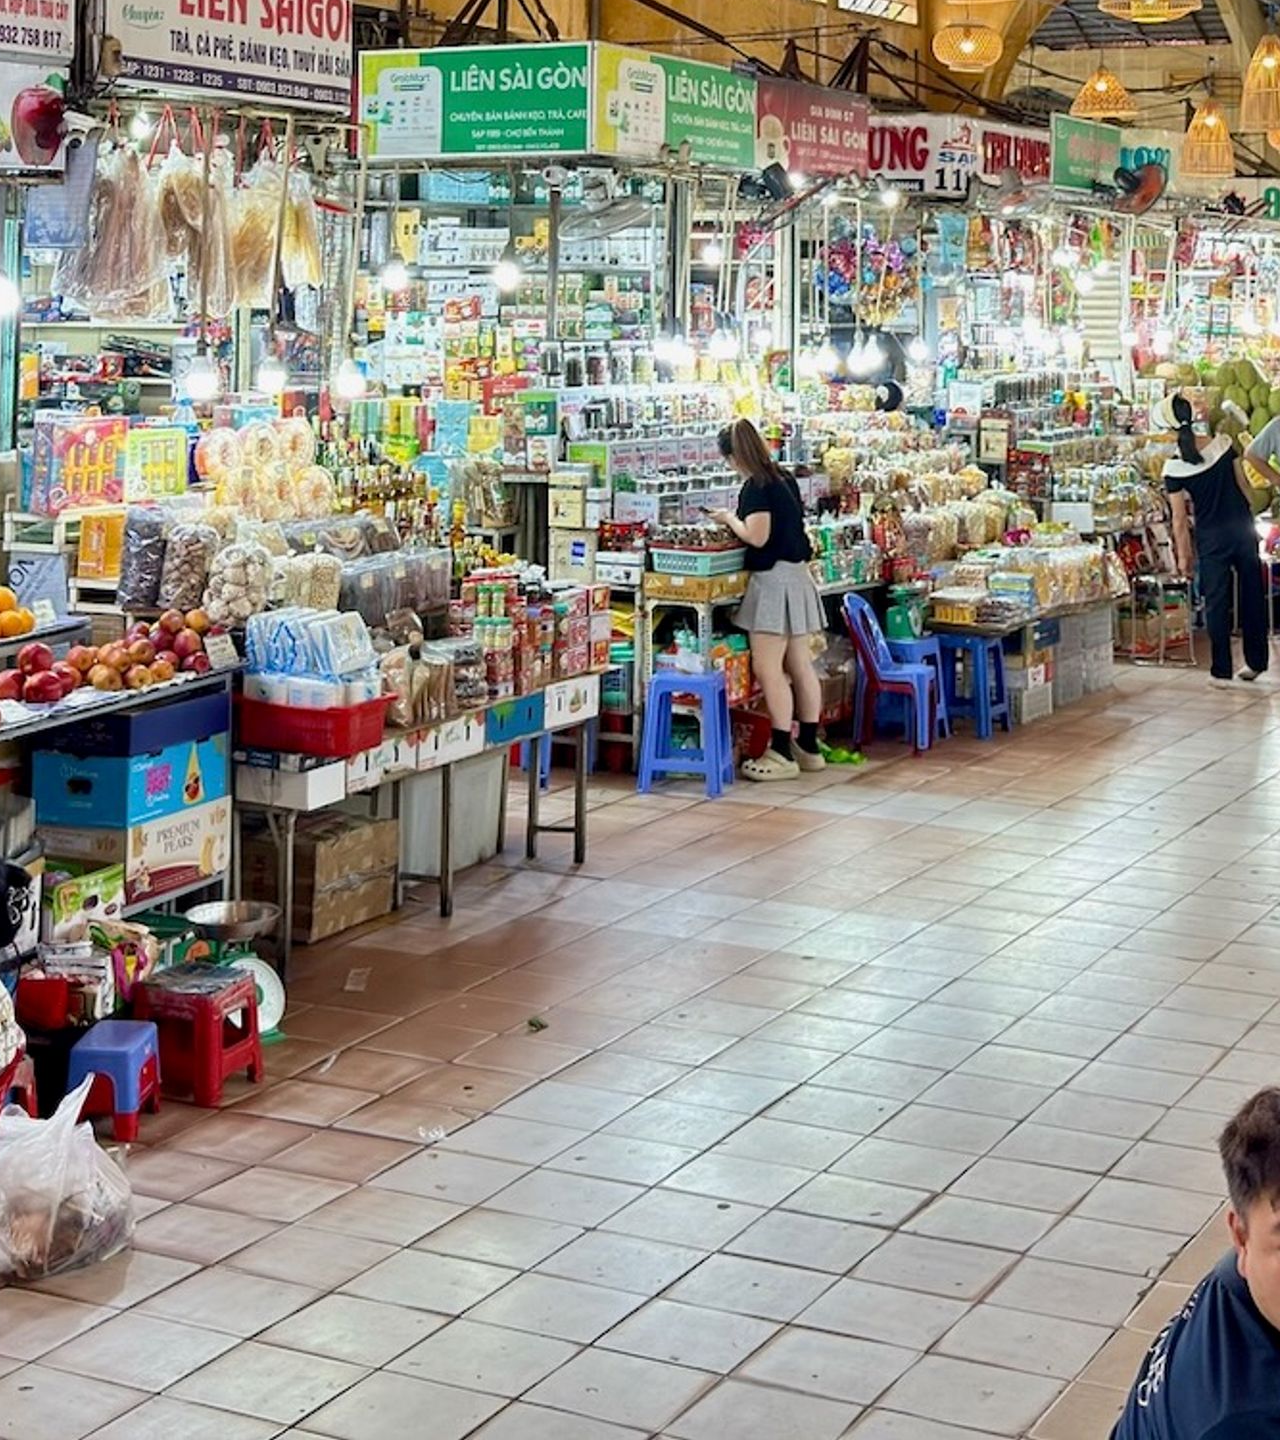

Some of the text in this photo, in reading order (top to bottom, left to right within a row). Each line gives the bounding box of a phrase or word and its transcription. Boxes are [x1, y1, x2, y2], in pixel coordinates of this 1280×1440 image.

[21, 27, 40, 47] 758
[43, 29, 61, 49] 817
[170, 26, 194, 54] TRÀ,
[196, 29, 211, 56] CÀ
[213, 33, 236, 63] PHÊ,
[239, 39, 267, 65] BÁNH
[450, 60, 588, 92] LIÊN SÀI GÒN
[668, 70, 756, 115] LIÊN SÀI GÒN
[791, 118, 816, 144] LIÊN
[820, 123, 839, 147] SÀI
[156, 818, 201, 845] PREMIUM
[163, 835, 194, 855] PEARS
